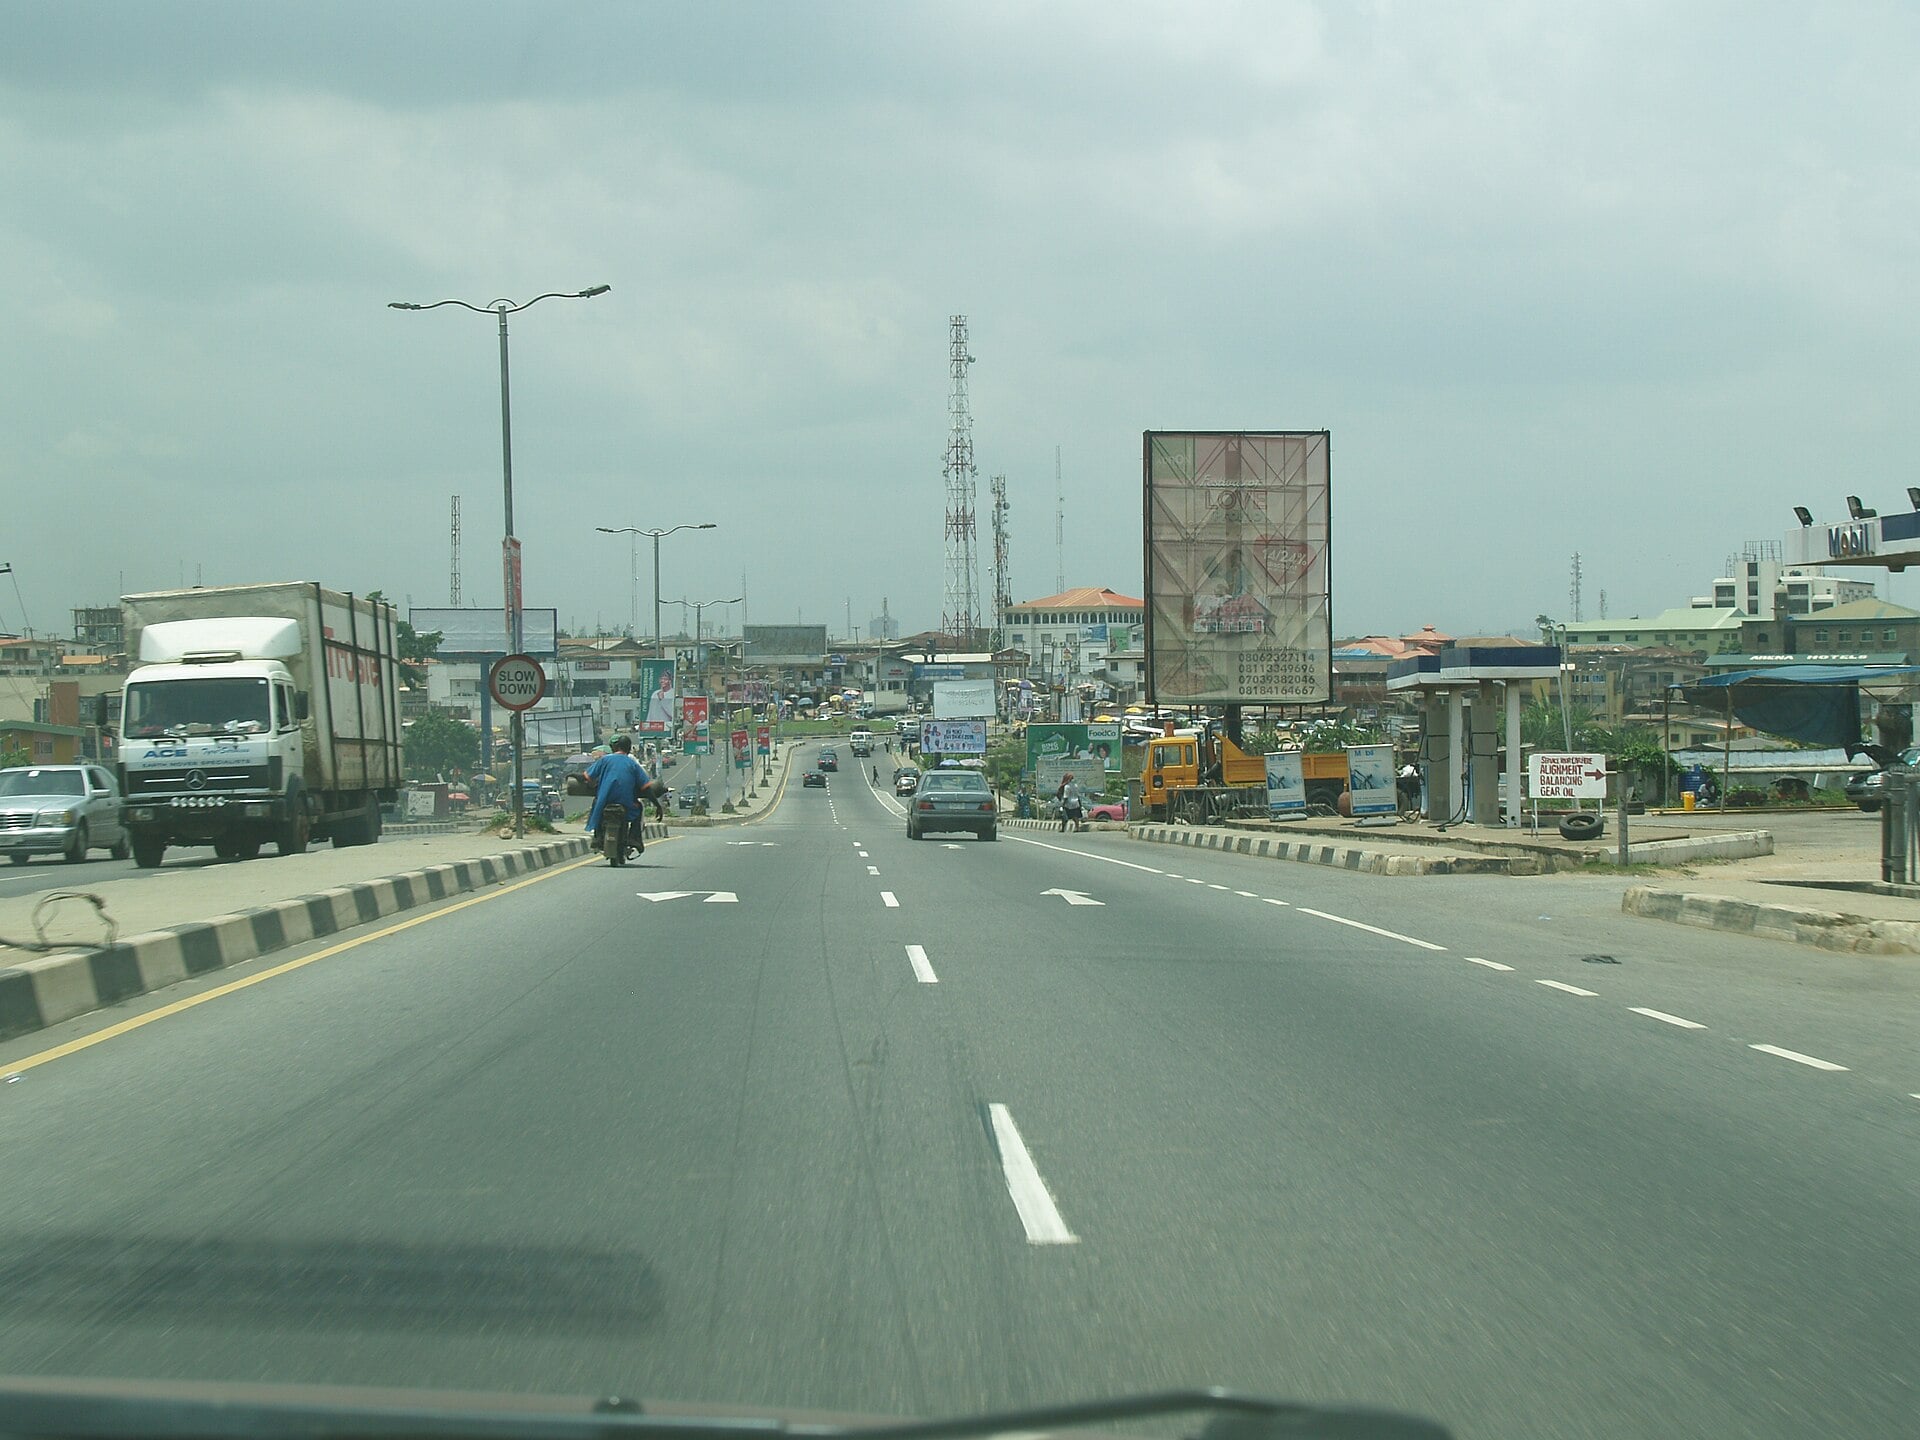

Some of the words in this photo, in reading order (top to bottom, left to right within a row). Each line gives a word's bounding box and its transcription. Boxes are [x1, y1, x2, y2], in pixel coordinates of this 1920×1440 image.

[1205, 490, 1267, 510] LOVE
[1828, 523, 1872, 557] Mobil
[1239, 653, 1315, 662] 08062327114
[1239, 664, 1315, 673] 08113349696
[499, 670, 536, 682] SLOW
[1239, 675, 1315, 684] 07039382046
[499, 683, 537, 695] DOWN
[1239, 686, 1315, 695] 08184164667
[1089, 728, 1116, 737] FoodCo
[143, 748, 188, 759] ACE
[1540, 764, 1583, 775] ALIGNMENT
[1540, 775, 1583, 786] BALANCING
[1540, 786, 1561, 796] GEAR
[1563, 787, 1576, 797] OIL
